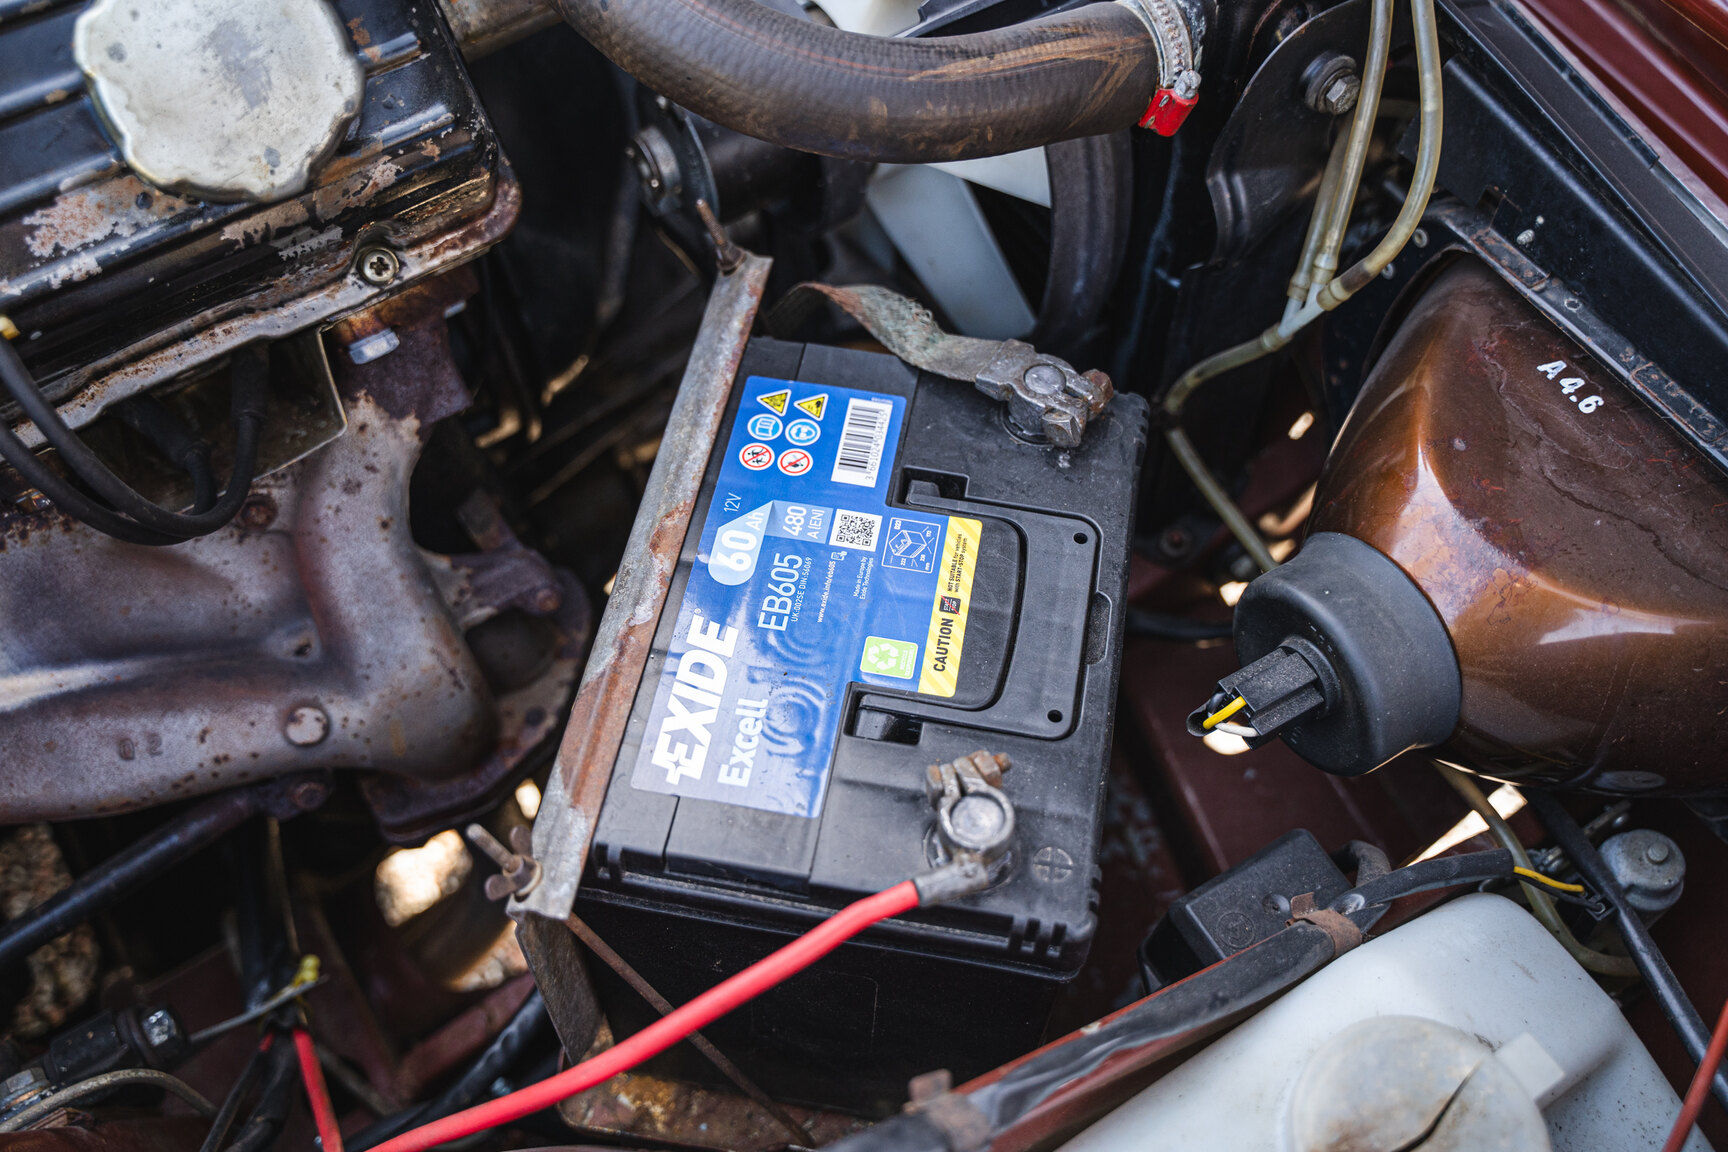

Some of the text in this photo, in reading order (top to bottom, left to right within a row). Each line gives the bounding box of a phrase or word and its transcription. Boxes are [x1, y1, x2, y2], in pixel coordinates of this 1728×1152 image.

[723, 491, 741, 512] 12V
[780, 504, 808, 536] 480
[806, 529, 819, 539] A
[713, 510, 765, 572] 60 Ah
[856, 561, 867, 578] Europe
[859, 557, 875, 599] Exide Technologies
[948, 558, 958, 581] SUITABLE
[954, 553, 965, 582] START-STOP
[756, 551, 804, 631] EB605
[790, 589, 805, 622] UK:002SE
[853, 583, 861, 597] Made
[931, 617, 954, 671] CAUTION
[651, 614, 739, 785] EXIDE
[716, 694, 769, 787] Excell
